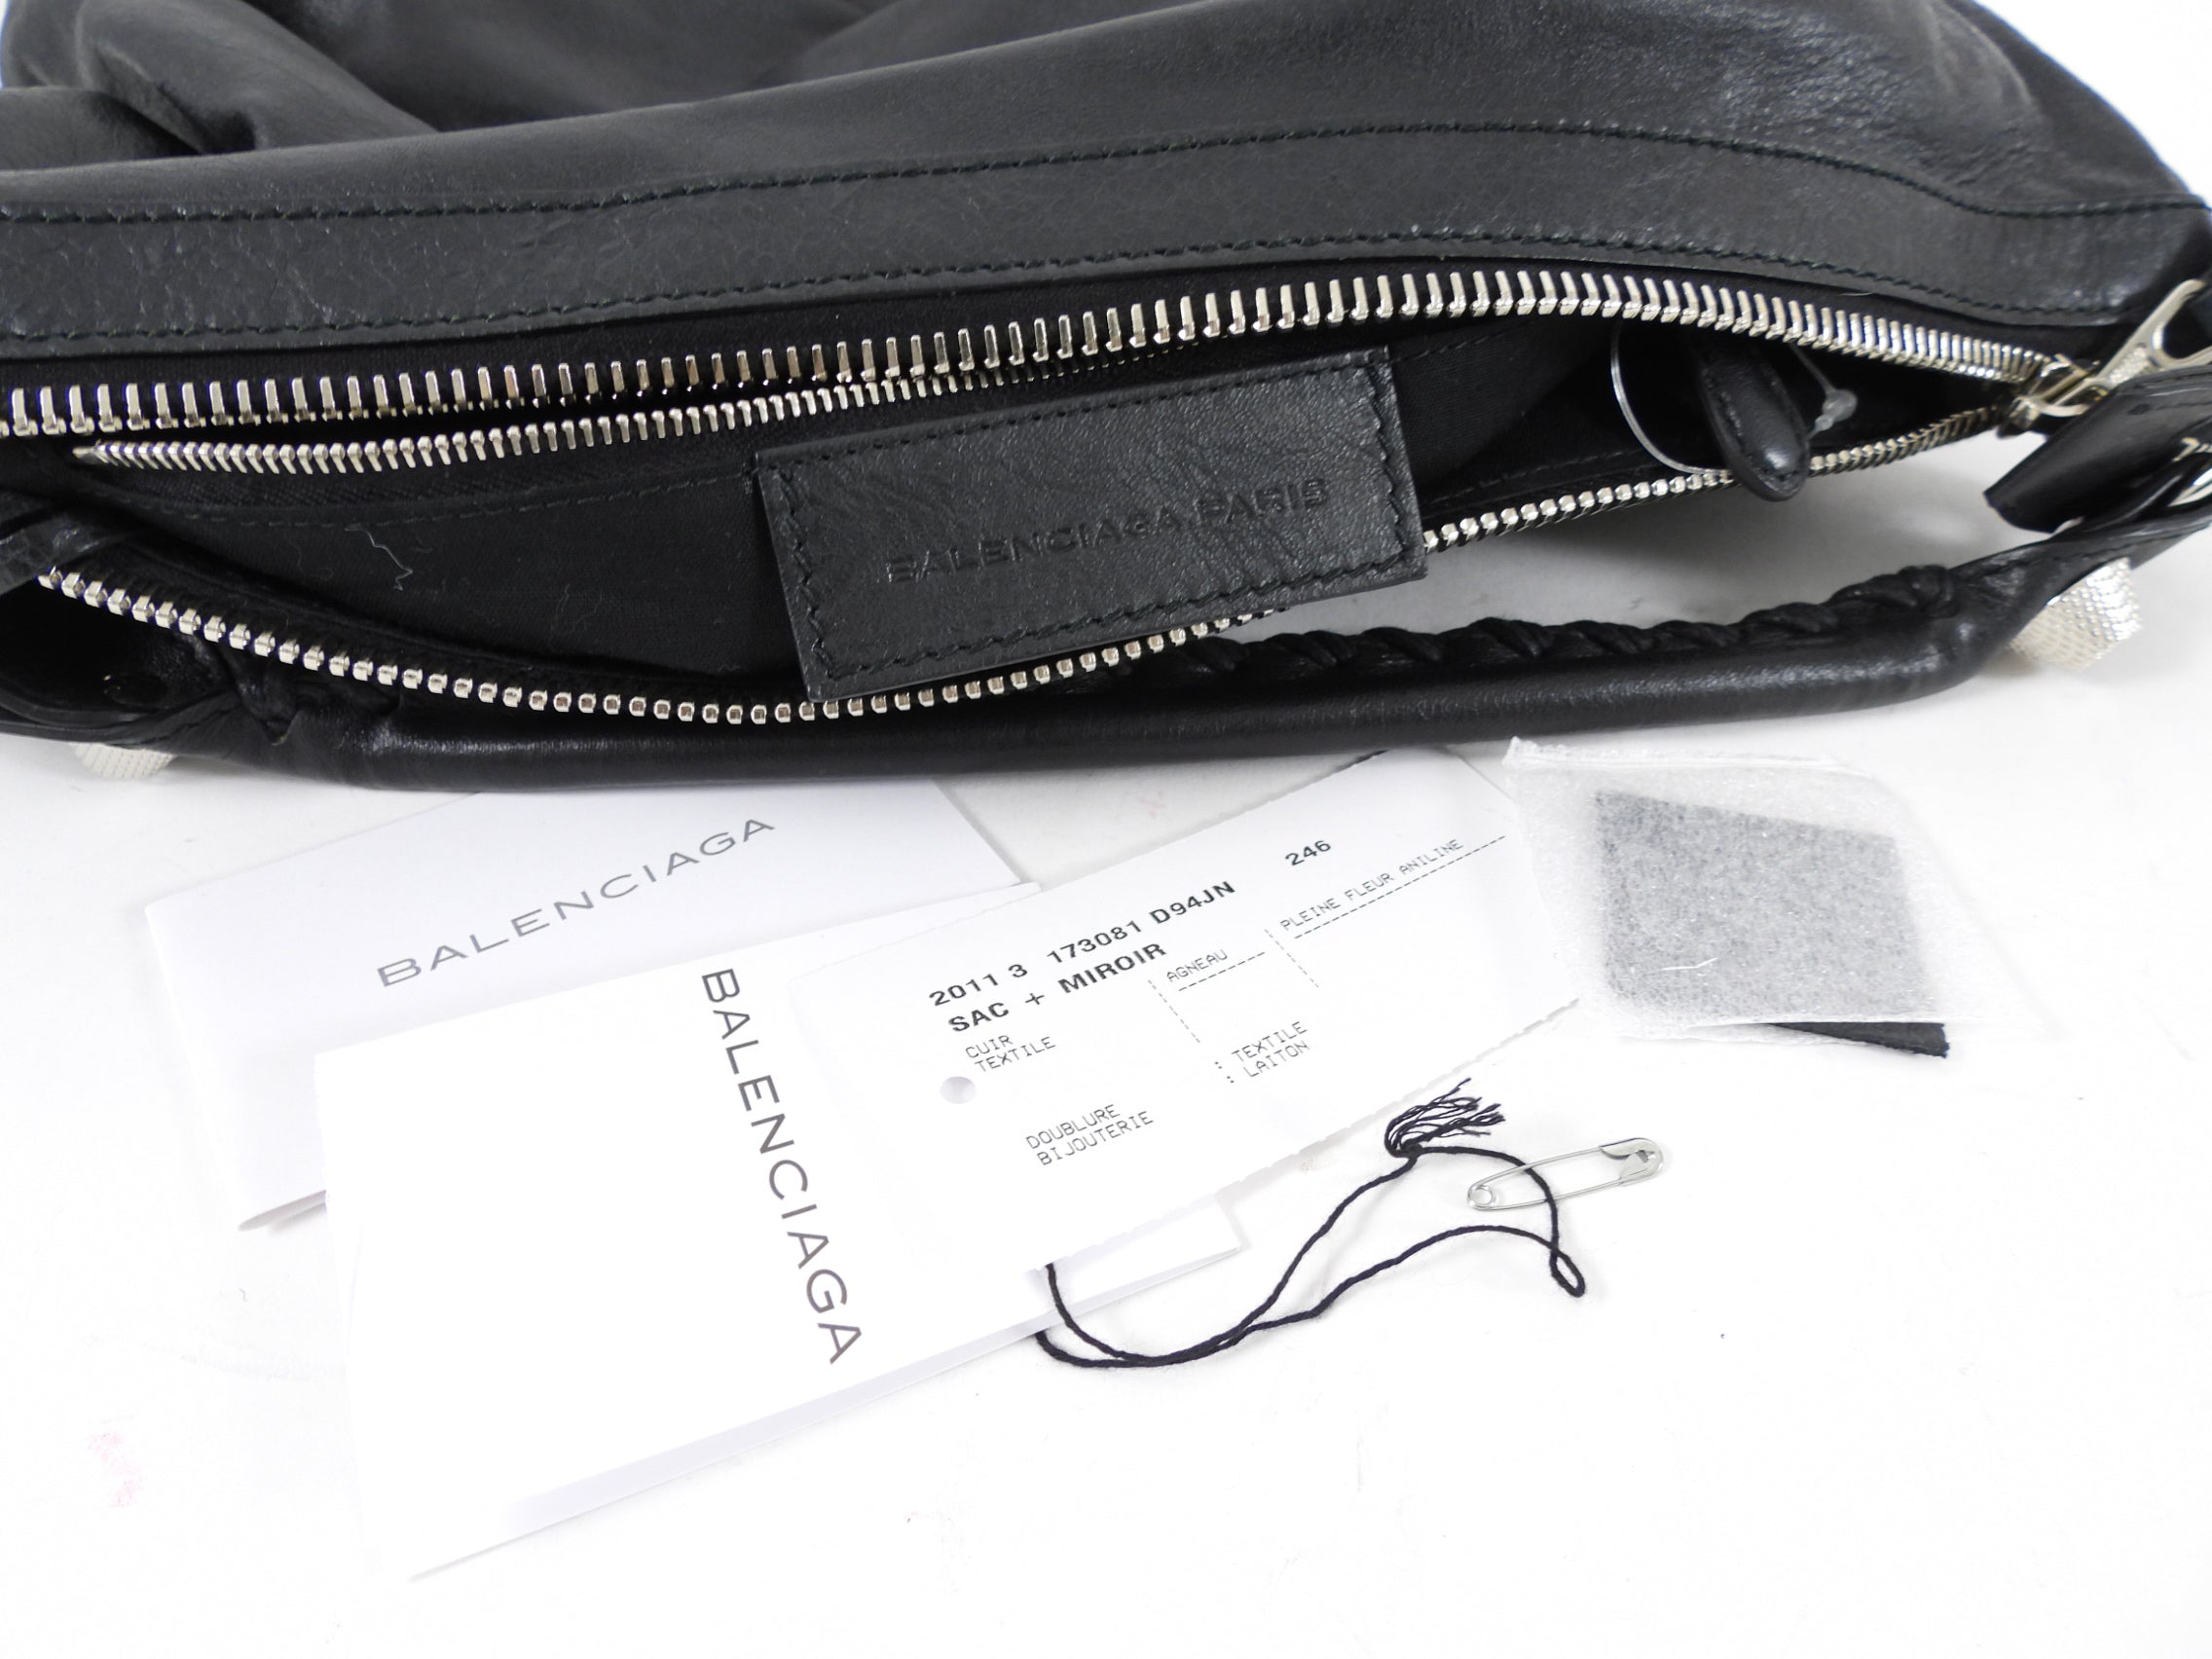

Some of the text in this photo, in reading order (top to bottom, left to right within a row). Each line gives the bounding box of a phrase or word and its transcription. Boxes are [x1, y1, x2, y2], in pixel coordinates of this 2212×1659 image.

[885, 477, 1331, 583] BALENCIAGA PARIS
[376, 818, 777, 987] BALENCIAGA
[929, 839, 1333, 1008] 2011 3 173081 D94JN 246
[1279, 838, 1464, 932] PLEINE FLEUR ANILINE
[947, 1001, 1010, 1033] SAC
[1057, 941, 1167, 995] MIROIR
[1165, 949, 1229, 983] AGNEAU
[965, 1035, 1014, 1059] CUIR
[975, 1036, 1056, 1072] TEXTILE
[1025, 1103, 1122, 1150] DOUBLURE
[1231, 1020, 1309, 1063] TEXTILE
[1036, 1110, 1155, 1165] BIJOUTERIE
[1242, 1040, 1311, 1078] LAITON
[700, 968, 864, 1365] BALENCIAGA
